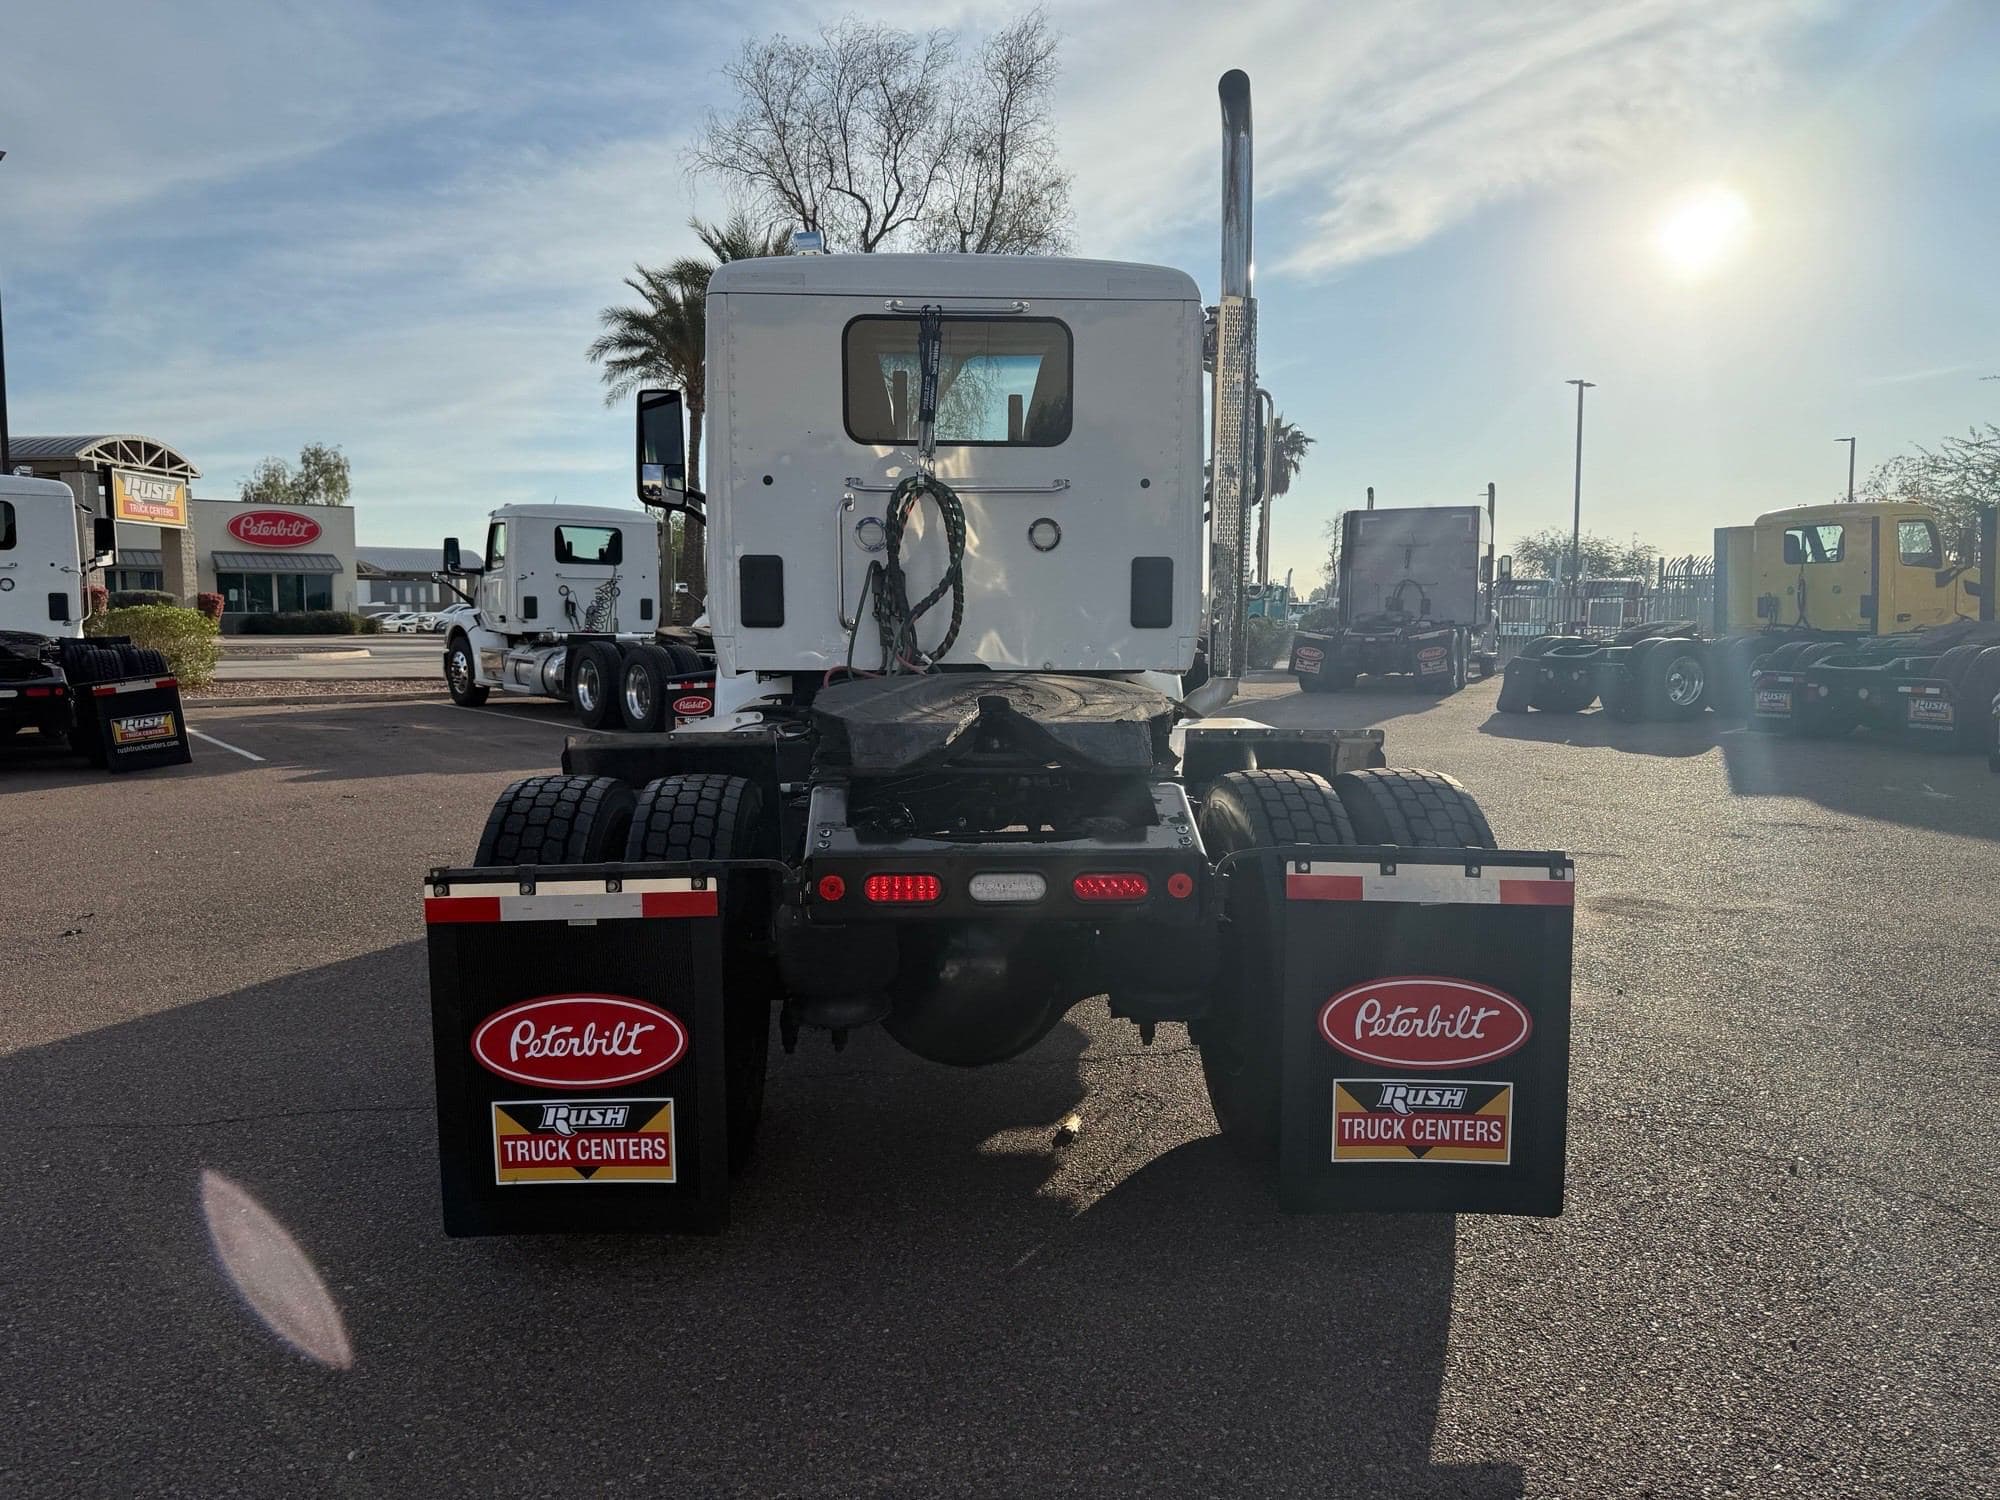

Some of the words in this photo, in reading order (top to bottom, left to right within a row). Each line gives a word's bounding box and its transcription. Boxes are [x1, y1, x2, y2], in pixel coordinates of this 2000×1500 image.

[124, 475, 177, 503] RUSH
[129, 503, 149, 514] TRUCK
[149, 504, 174, 517] CENTERS
[239, 516, 314, 538] Peterbilt
[120, 716, 165, 731] RUSH
[117, 741, 179, 754] rushtruckcenters.com
[1354, 998, 1500, 1041] Peterbilt
[509, 1019, 656, 1063] Peterbilt
[1376, 1083, 1467, 1116] RUSH
[538, 1104, 629, 1137] RUSH
[1341, 1118, 1406, 1140] TRUCK
[1411, 1119, 1502, 1143] CENTERS
[503, 1139, 572, 1162] TRUCK
[576, 1137, 667, 1161] CENTERS
